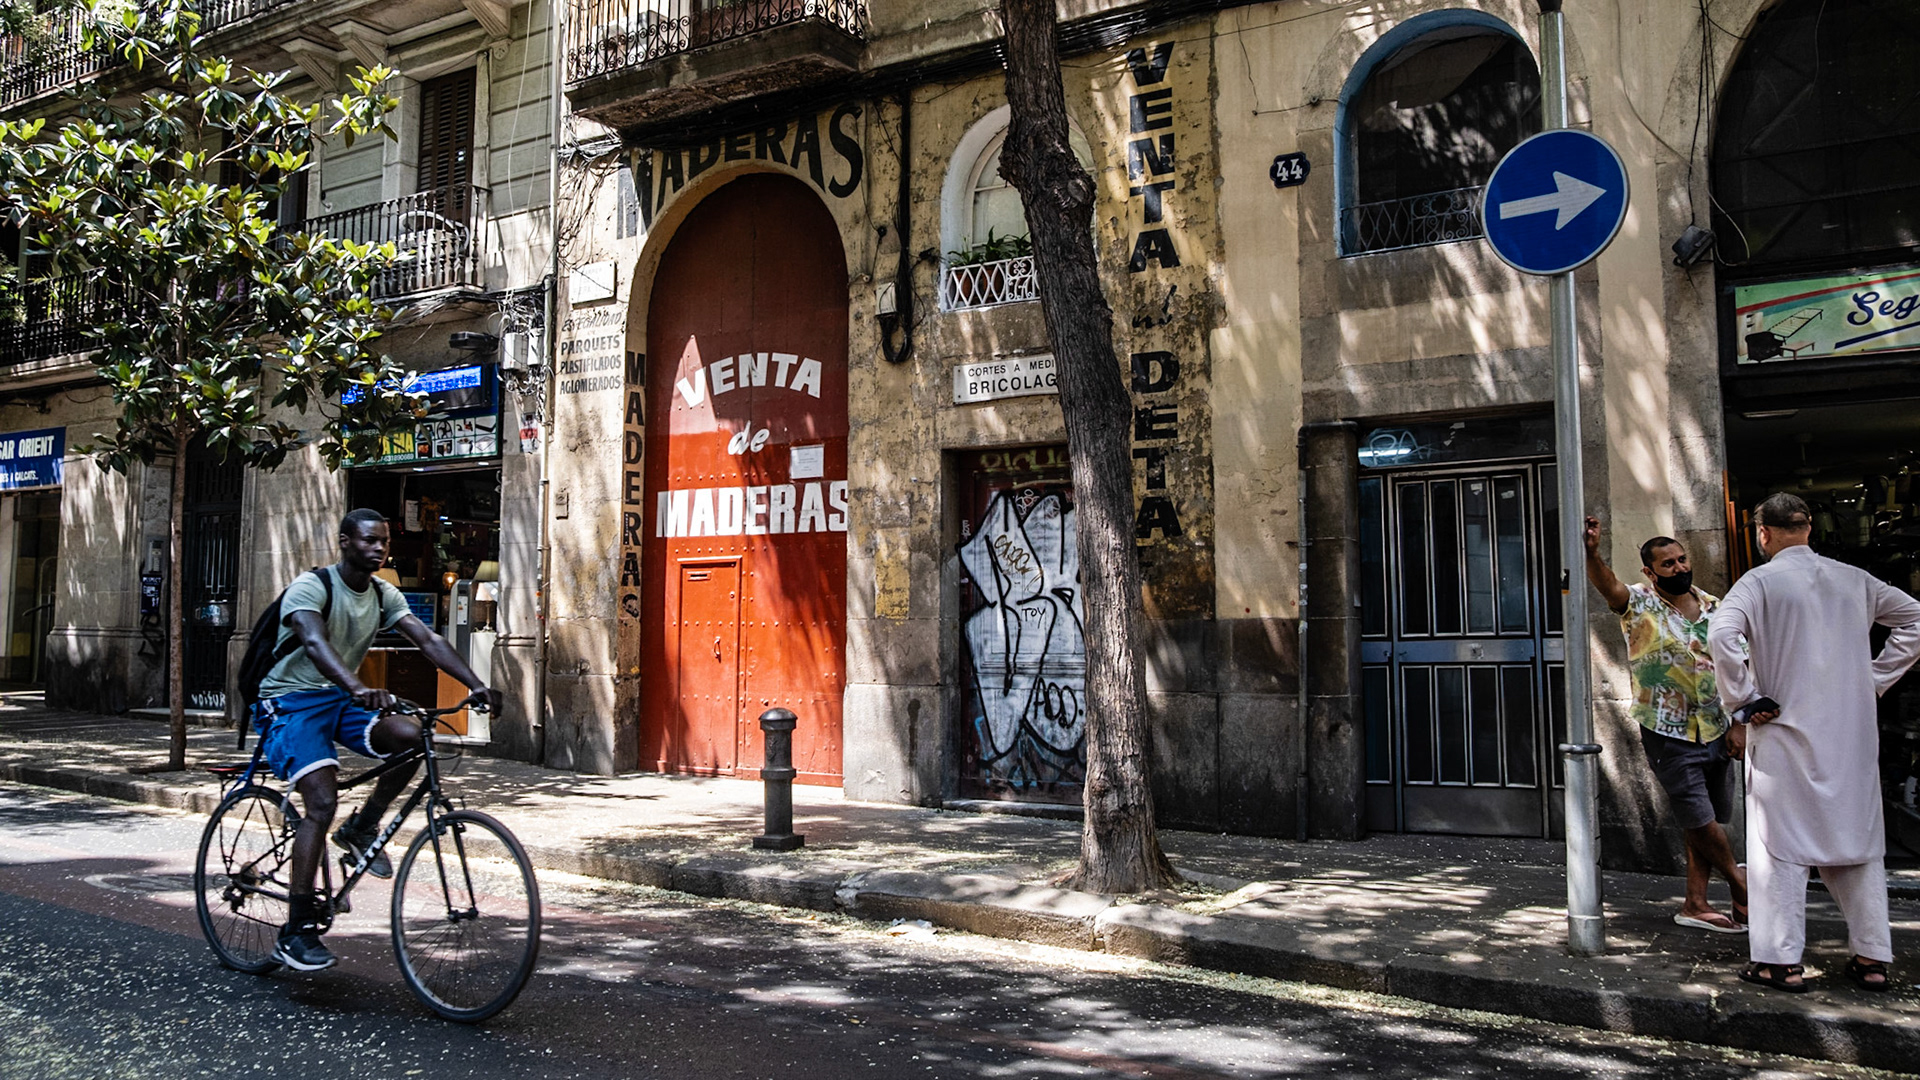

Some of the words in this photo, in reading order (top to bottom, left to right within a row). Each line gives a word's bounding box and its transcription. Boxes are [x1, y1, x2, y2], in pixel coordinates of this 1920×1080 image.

[1126, 40, 1180, 273] VENTA
[616, 103, 864, 240] MADERAS
[1276, 158, 1303, 182] 44
[1846, 291, 1920, 326] Seg
[560, 334, 620, 356] PARQUETS
[560, 354, 622, 375] PLASTIFICADOS
[968, 364, 1006, 377] CORTES
[1013, 363, 1021, 373] A
[560, 375, 621, 395] AGLOMERADOS
[675, 352, 823, 408] VENTA
[18, 434, 55, 459] ORIENT
[727, 420, 770, 456] de
[656, 480, 848, 538] MADERAS
[1022, 607, 1045, 633] TOY
